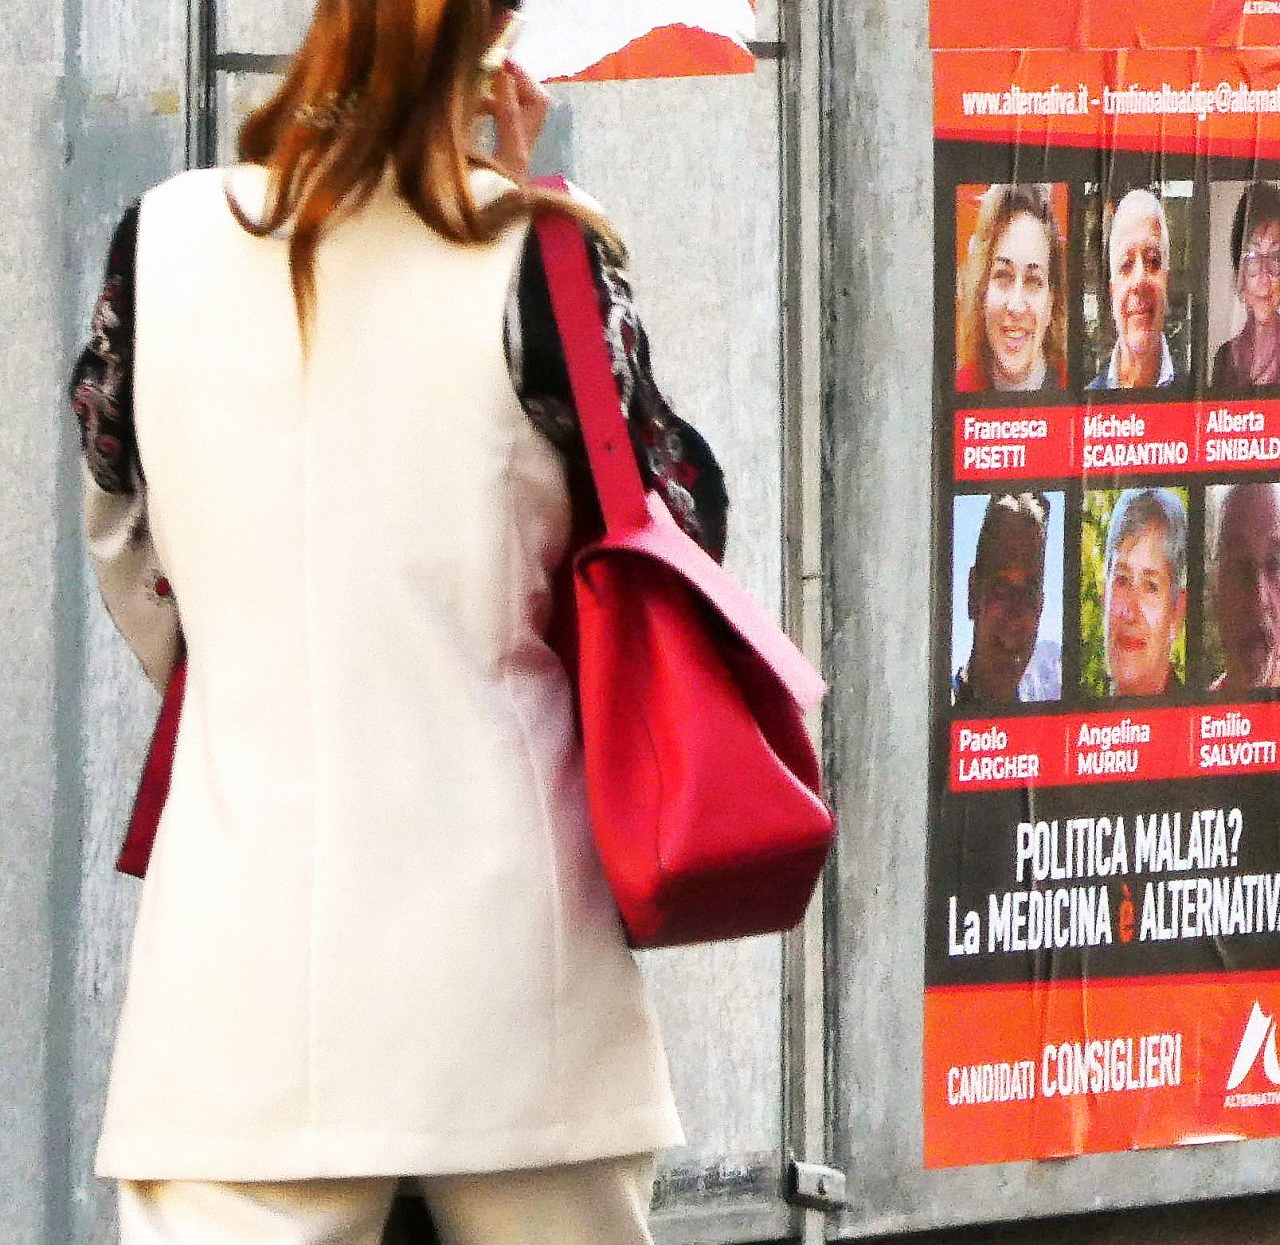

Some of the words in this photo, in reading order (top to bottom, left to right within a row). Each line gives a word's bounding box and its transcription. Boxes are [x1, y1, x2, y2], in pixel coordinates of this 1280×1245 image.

[961, 84, 1089, 115] www.alternativa.it
[963, 416, 1047, 441] Francesca
[1082, 413, 1145, 438] Michele
[1206, 409, 1265, 434] Alberta
[963, 444, 1026, 469] PISETTI
[1082, 441, 1189, 467] SCARANTINO
[1077, 719, 1151, 748] Angelina
[1200, 712, 1251, 739] Emilio
[958, 727, 1008, 752] Paolo
[958, 754, 1040, 782] LARGHER
[1077, 750, 1139, 775] MURRU
[1199, 740, 1277, 769] SALVOTTI
[1016, 816, 1128, 883] POLITICA
[1134, 807, 1244, 872] MALATA?
[947, 896, 980, 957] La
[987, 885, 1114, 953] MEDICINA
[1118, 882, 1135, 943] è
[947, 1060, 1036, 1107] CANDIDATI
[1040, 1032, 1182, 1099] CONSIGLIERI
